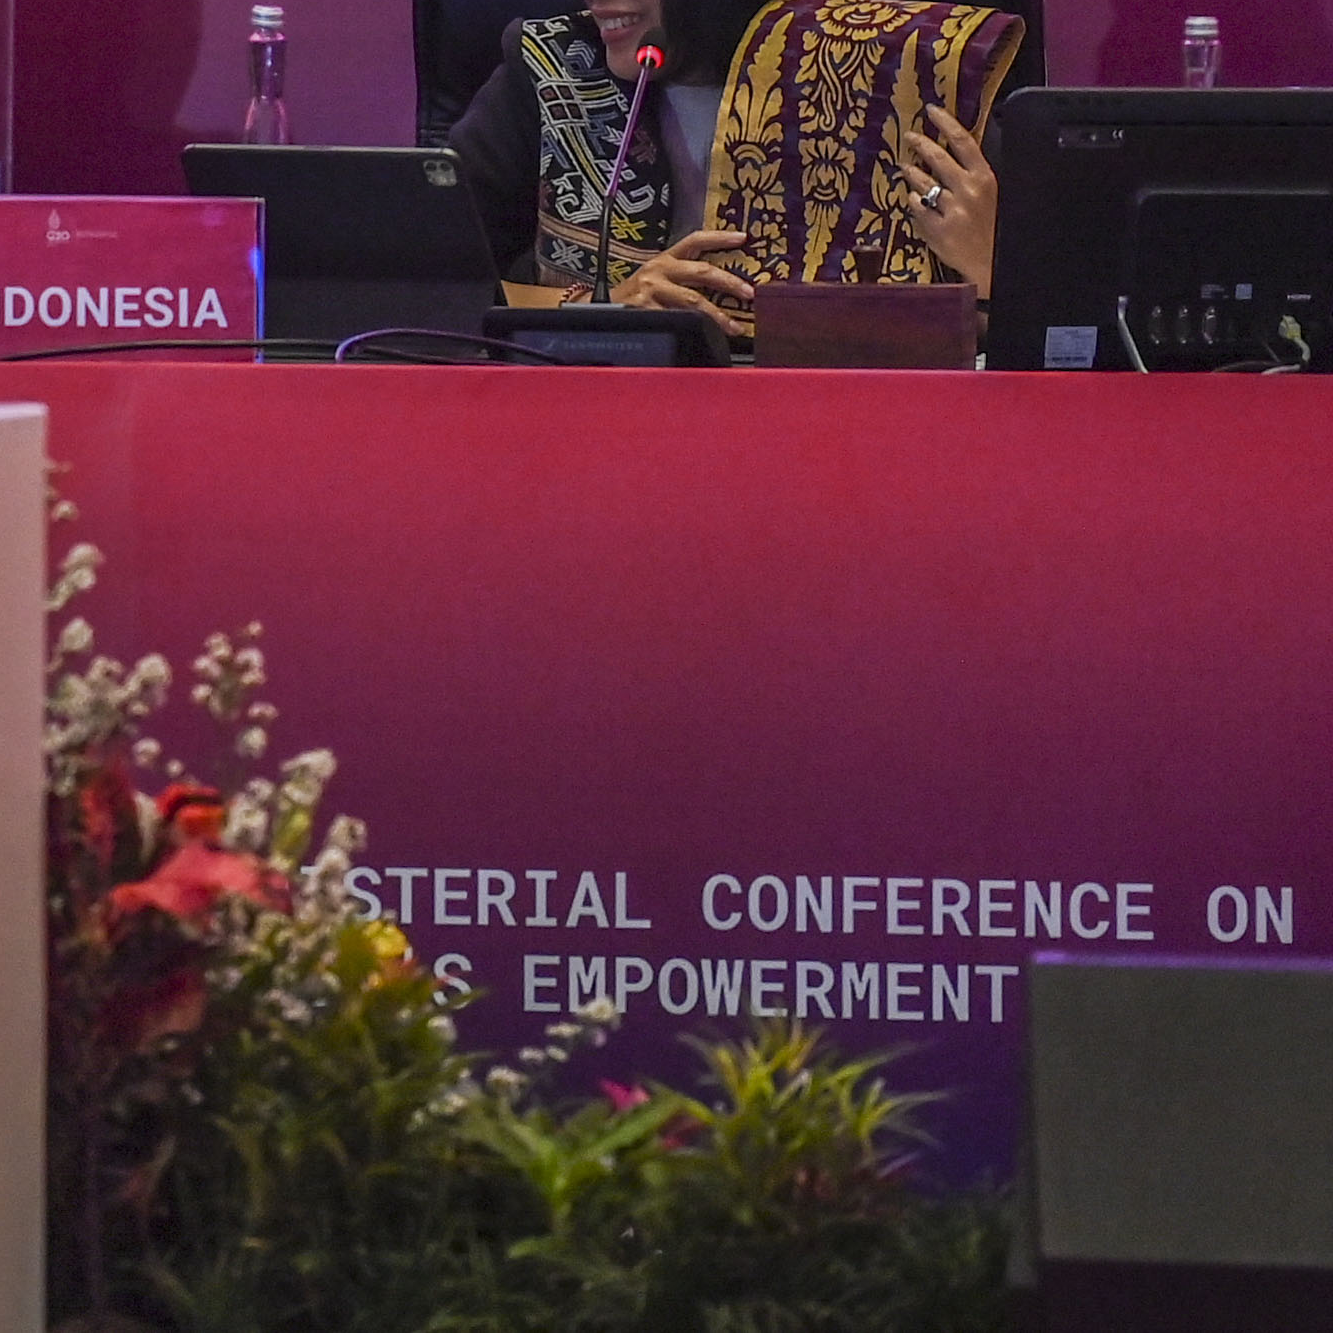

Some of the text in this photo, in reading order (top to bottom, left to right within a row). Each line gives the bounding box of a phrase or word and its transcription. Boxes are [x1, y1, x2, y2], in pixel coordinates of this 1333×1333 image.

[701, 872, 1155, 942] CONFERENCE
[1205, 885, 1294, 945] ON
[522, 953, 1020, 1024] EMPOWERMENT
